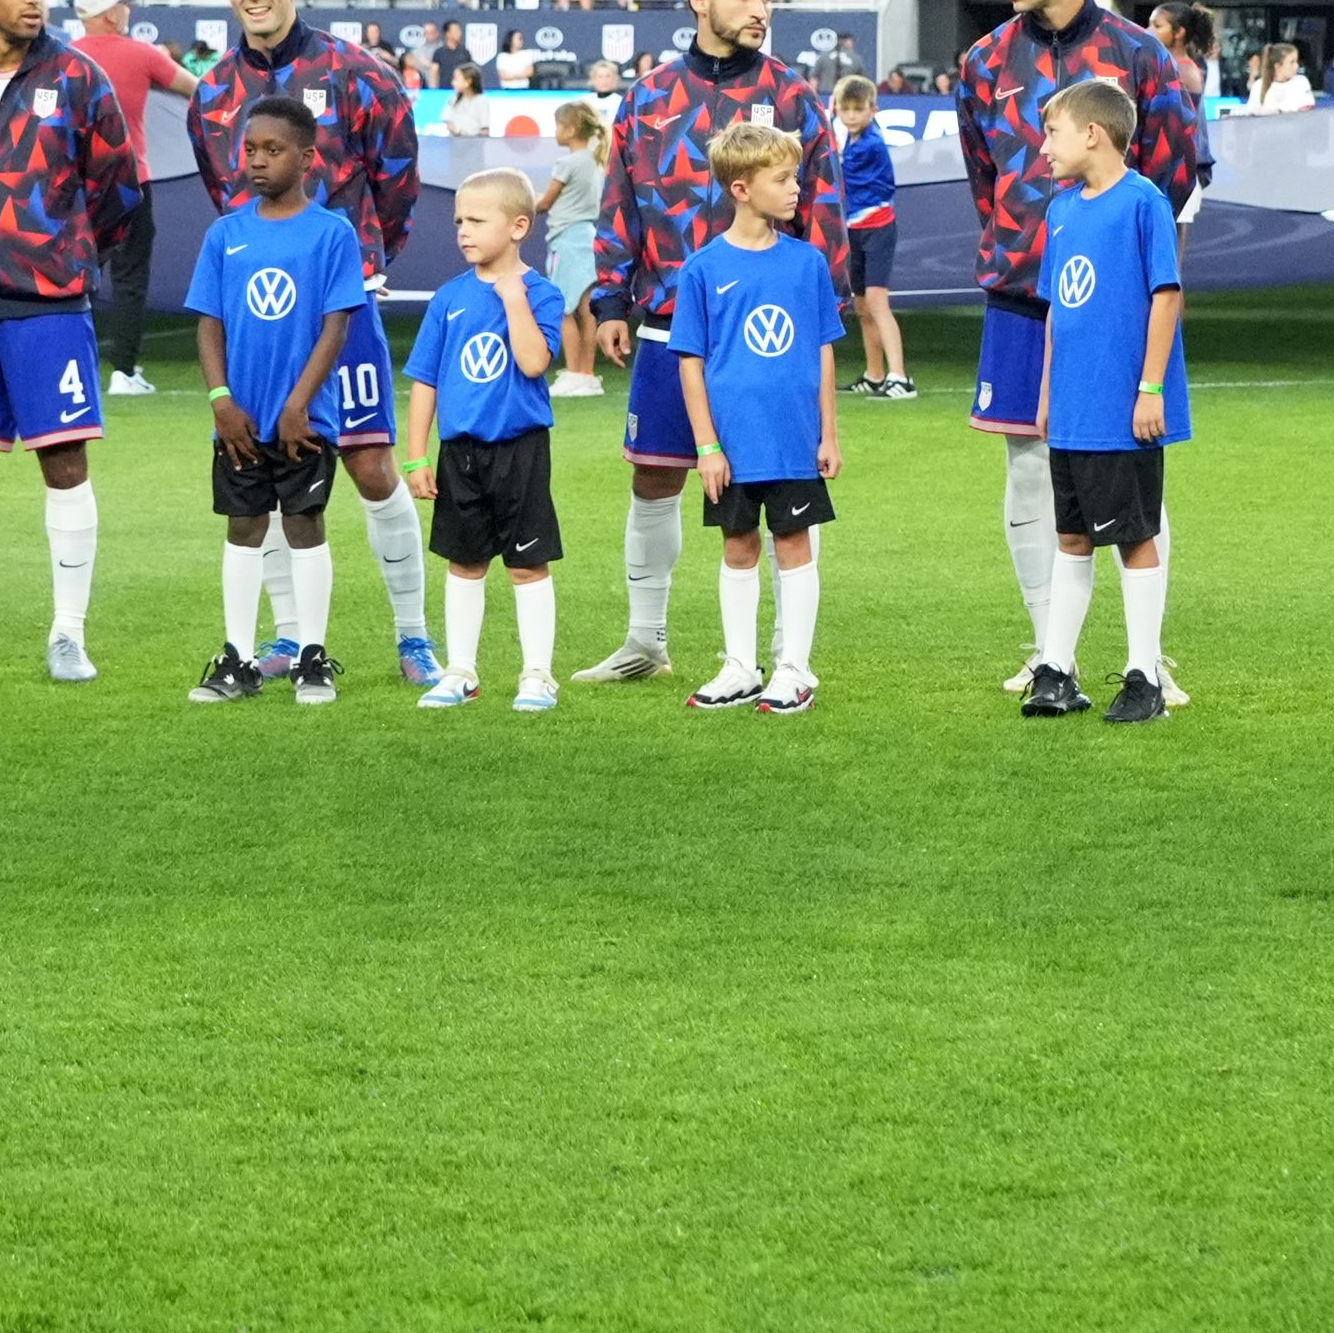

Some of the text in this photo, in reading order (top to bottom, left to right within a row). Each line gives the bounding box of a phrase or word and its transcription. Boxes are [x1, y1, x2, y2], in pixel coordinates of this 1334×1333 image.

[247, 267, 296, 320] VW
[1060, 256, 1096, 308] VW
[744, 303, 794, 357] VW
[59, 359, 86, 403] 4
[460, 332, 507, 383] VW
[337, 363, 378, 409] 10
